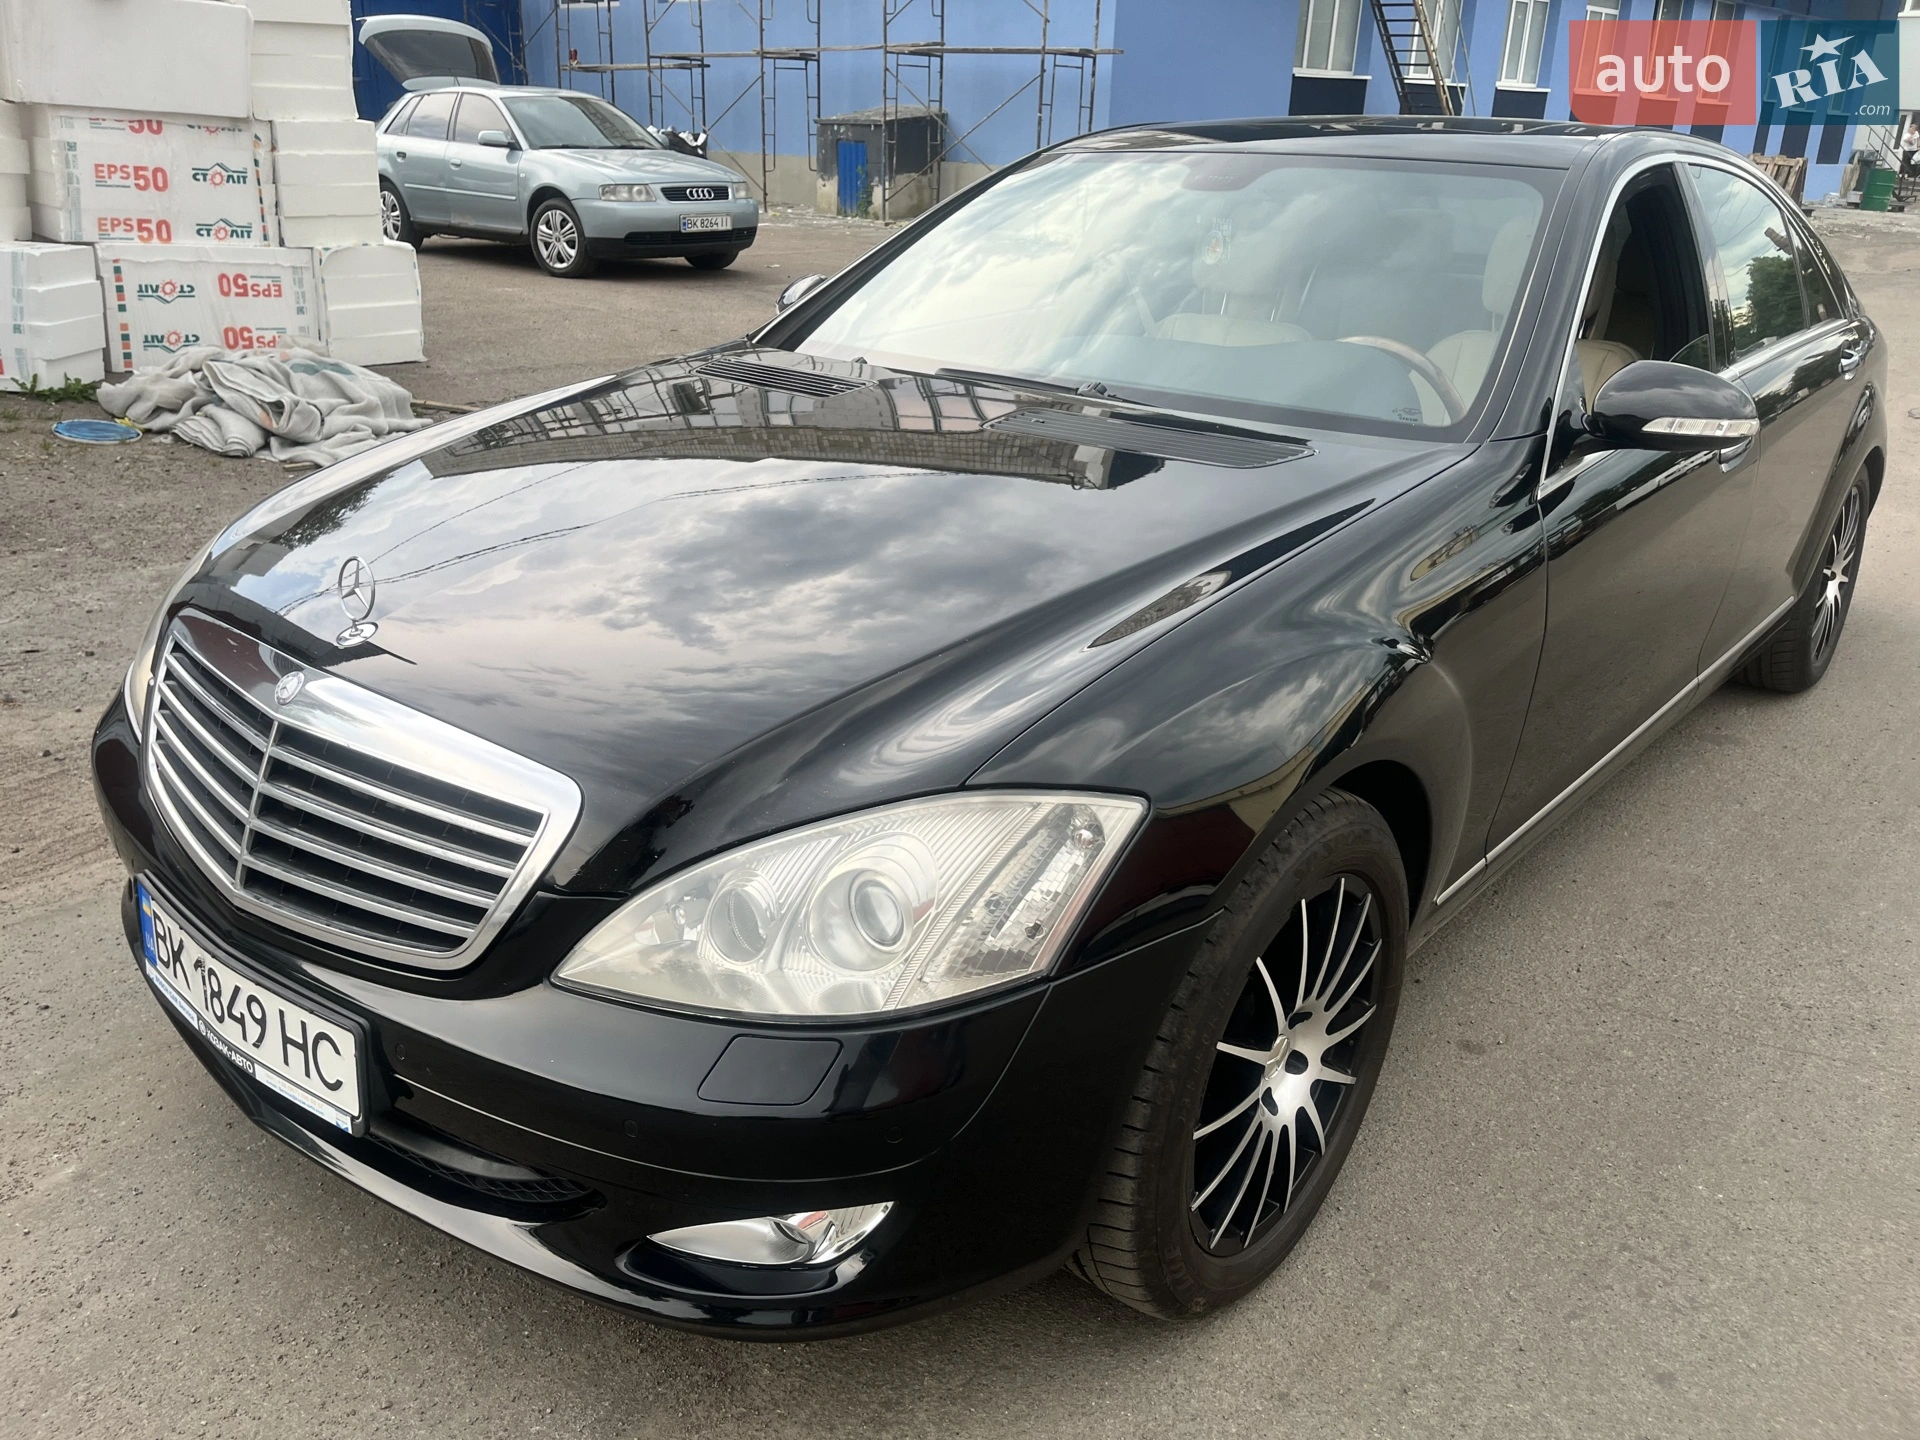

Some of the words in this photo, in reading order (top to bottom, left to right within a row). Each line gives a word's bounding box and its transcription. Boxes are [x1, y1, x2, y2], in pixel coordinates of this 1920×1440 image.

[686, 218, 699, 229] BK
[700, 217, 719, 229] 8264
[152, 908, 192, 992] BK
[194, 955, 267, 1049] 1849
[278, 1007, 343, 1092] HC
